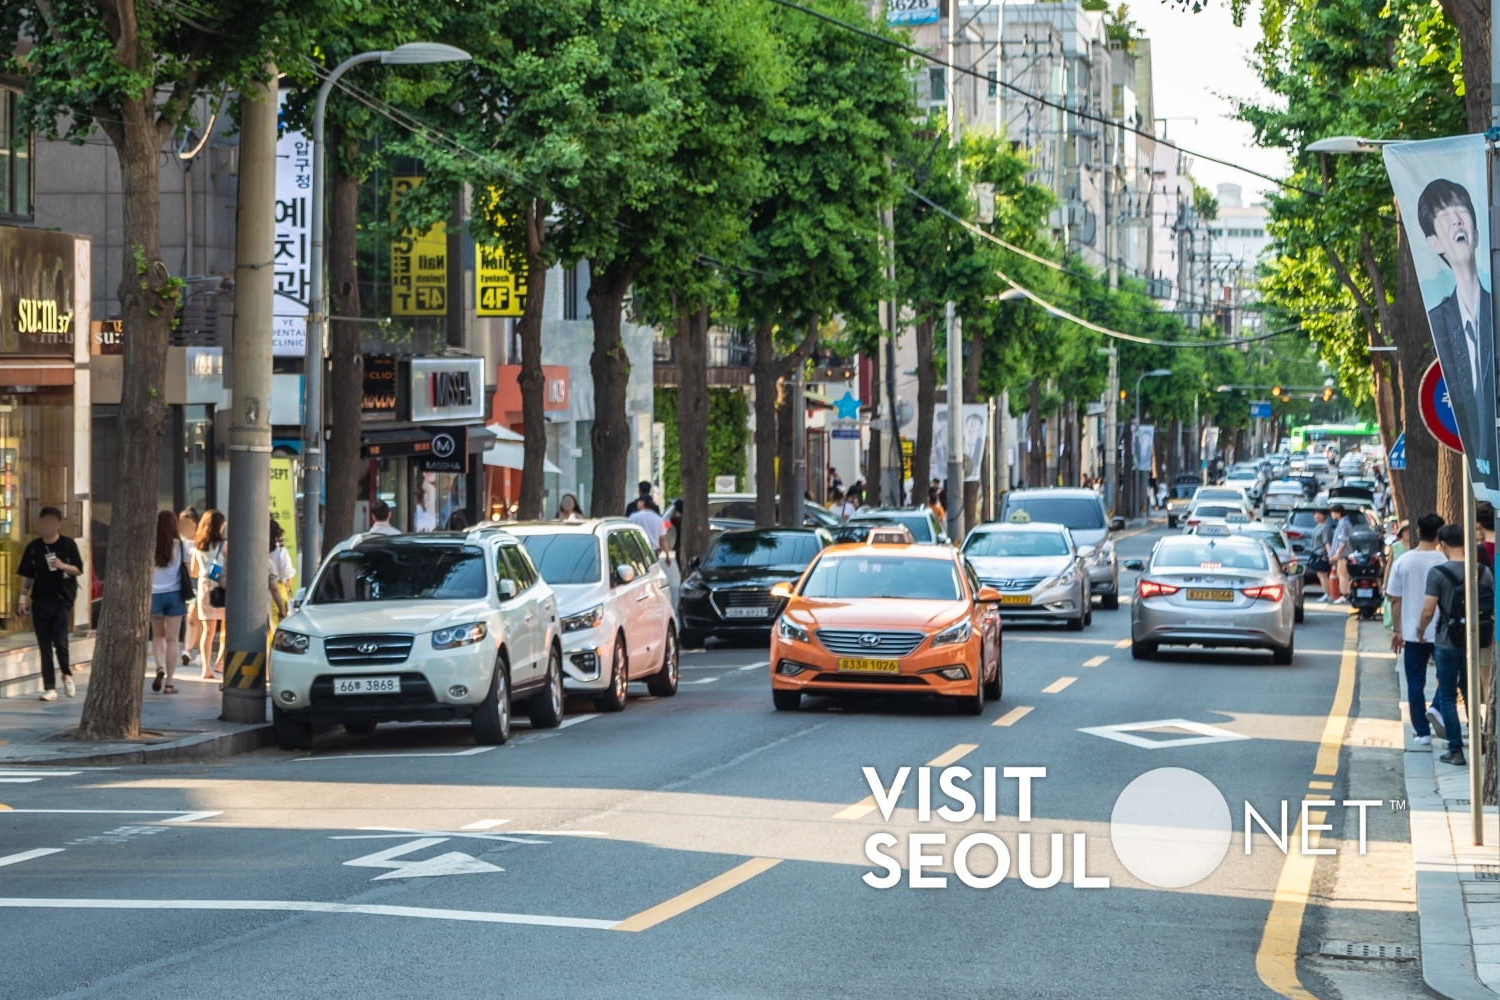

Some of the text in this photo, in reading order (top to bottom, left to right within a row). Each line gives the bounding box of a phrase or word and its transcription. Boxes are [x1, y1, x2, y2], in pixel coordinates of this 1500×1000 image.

[295, 141, 311, 189] 압구정
[275, 197, 310, 302] 예치과
[481, 275, 510, 284] Eyelash
[483, 288, 508, 308] 4F
[283, 319, 294, 327] YE
[95, 331, 123, 345] su:
[426, 461, 461, 470] MISSHA
[870, 660, 896, 671] 1026
[366, 680, 394, 691] 3868
